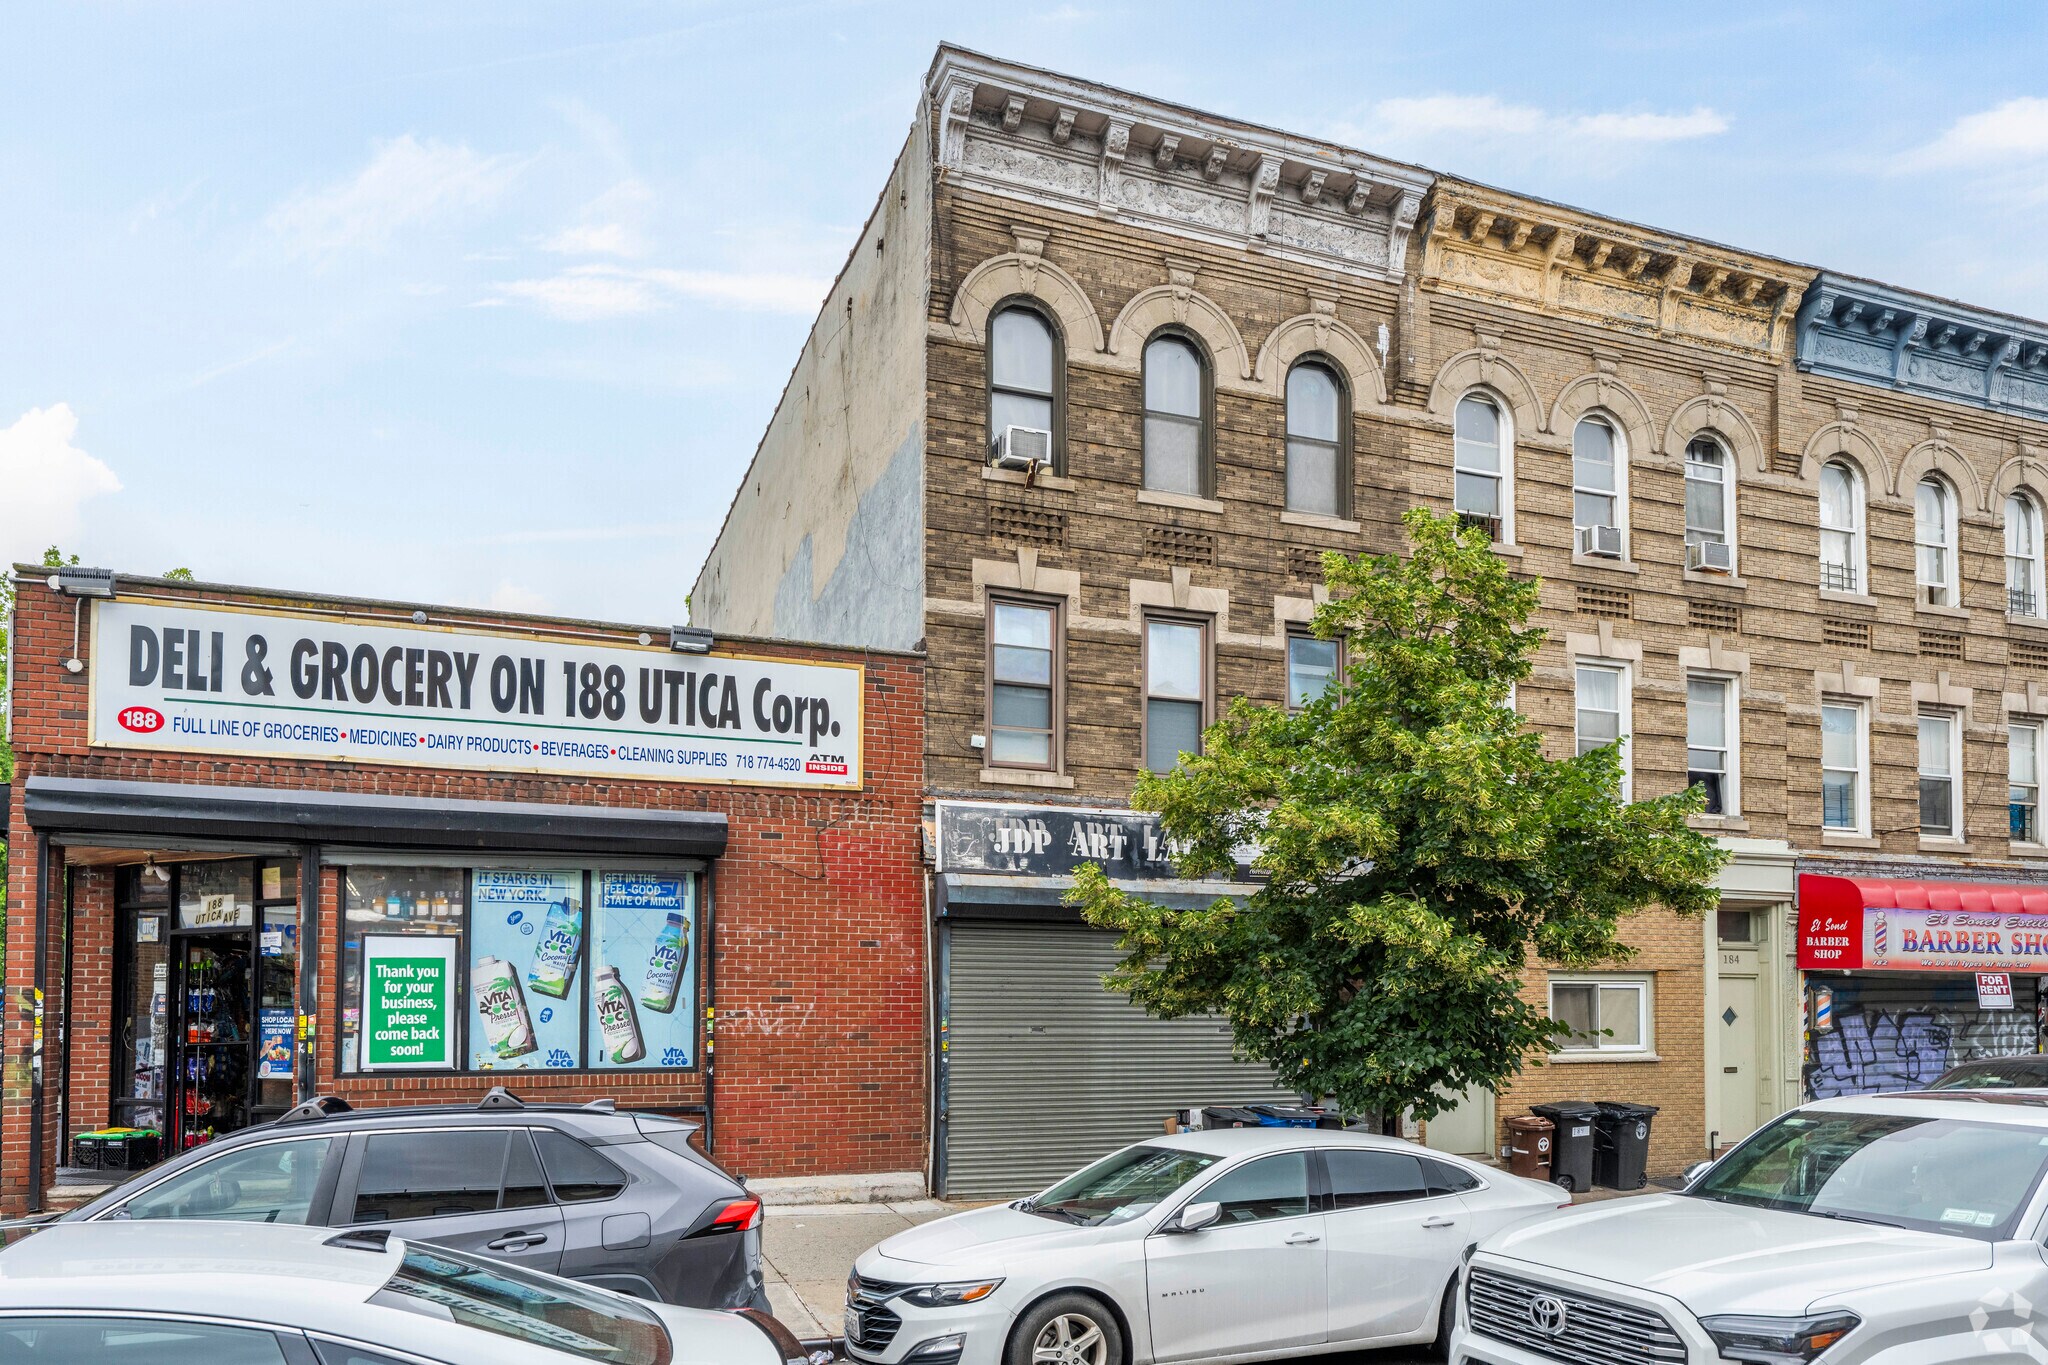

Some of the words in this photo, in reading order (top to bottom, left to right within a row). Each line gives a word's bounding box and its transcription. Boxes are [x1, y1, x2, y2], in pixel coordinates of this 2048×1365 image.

[129, 624, 224, 692] DELI
[241, 634, 275, 696] &
[290, 638, 479, 710] GROCERY
[490, 652, 545, 715] ON
[563, 661, 625, 721] 188
[639, 668, 741, 730] UTICA
[753, 678, 840, 747] Corp.
[123, 711, 157, 728] 188
[173, 717, 206, 734] FULL
[210, 719, 239, 735] LINE
[242, 721, 261, 738] OF
[263, 723, 339, 742] GROCERIES
[349, 728, 417, 748] MEDICINES
[427, 733, 463, 750] DAIRY
[467, 737, 532, 755] PRODUCTS
[541, 741, 609, 760] BEVERAGES
[618, 746, 674, 764] CLEANING
[677, 752, 728, 768] SUPPLIES
[736, 754, 754, 768] 718
[757, 756, 801, 771] 774-4520
[809, 754, 844, 763] ATM
[808, 764, 845, 772] INSIDE
[993, 828, 1051, 855] JDP
[1071, 832, 1128, 860] ART
[479, 872, 490, 883] IT
[493, 872, 537, 885] STARTS
[540, 874, 552, 885] IN
[604, 873, 623, 883] GET
[625, 874, 635, 883] IN
[637, 874, 656, 884] THE
[479, 888, 506, 900] NEW
[509, 888, 546, 901] YORK.
[604, 884, 660, 895] FEEL-GOOD
[207, 898, 223, 912] 188
[604, 895, 633, 905] STATE
[635, 896, 648, 906] OF
[650, 896, 678, 907] MIND.
[195, 910, 221, 925] UTICA
[223, 908, 240, 924] AVE
[1925, 913, 1950, 926] El
[550, 929, 572, 946] VITA
[1806, 937, 1849, 947] BARBER
[1902, 928, 2004, 955] BARBER
[544, 940, 573, 955] COCO
[654, 945, 678, 961] VITA
[1814, 949, 1842, 959] SHOP
[649, 957, 679, 972] COCO
[1723, 955, 1740, 964] 184
[1920, 959, 1933, 967] We
[1935, 959, 1945, 967] Do
[1961, 960, 1982, 968] Types
[1996, 960, 2012, 968] Hair
[375, 964, 414, 978] Thank
[417, 967, 439, 981] you
[1981, 975, 2003, 985] FOR
[384, 980, 403, 993] for
[406, 983, 434, 996] your
[1980, 985, 2008, 994] RENT
[381, 996, 437, 1010] business,
[484, 991, 512, 1005] VITA
[597, 1000, 626, 1015] VITA
[387, 1011, 427, 1028] please
[600, 1010, 630, 1026] COCO
[375, 1030, 408, 1040] come
[411, 1026, 439, 1039] back
[390, 1042, 423, 1056] soon!
[548, 1048, 570, 1059] VITA
[663, 1047, 684, 1057] VITA
[661, 1057, 688, 1065] COCO
[1161, 1288, 1205, 1297] MALIBU
